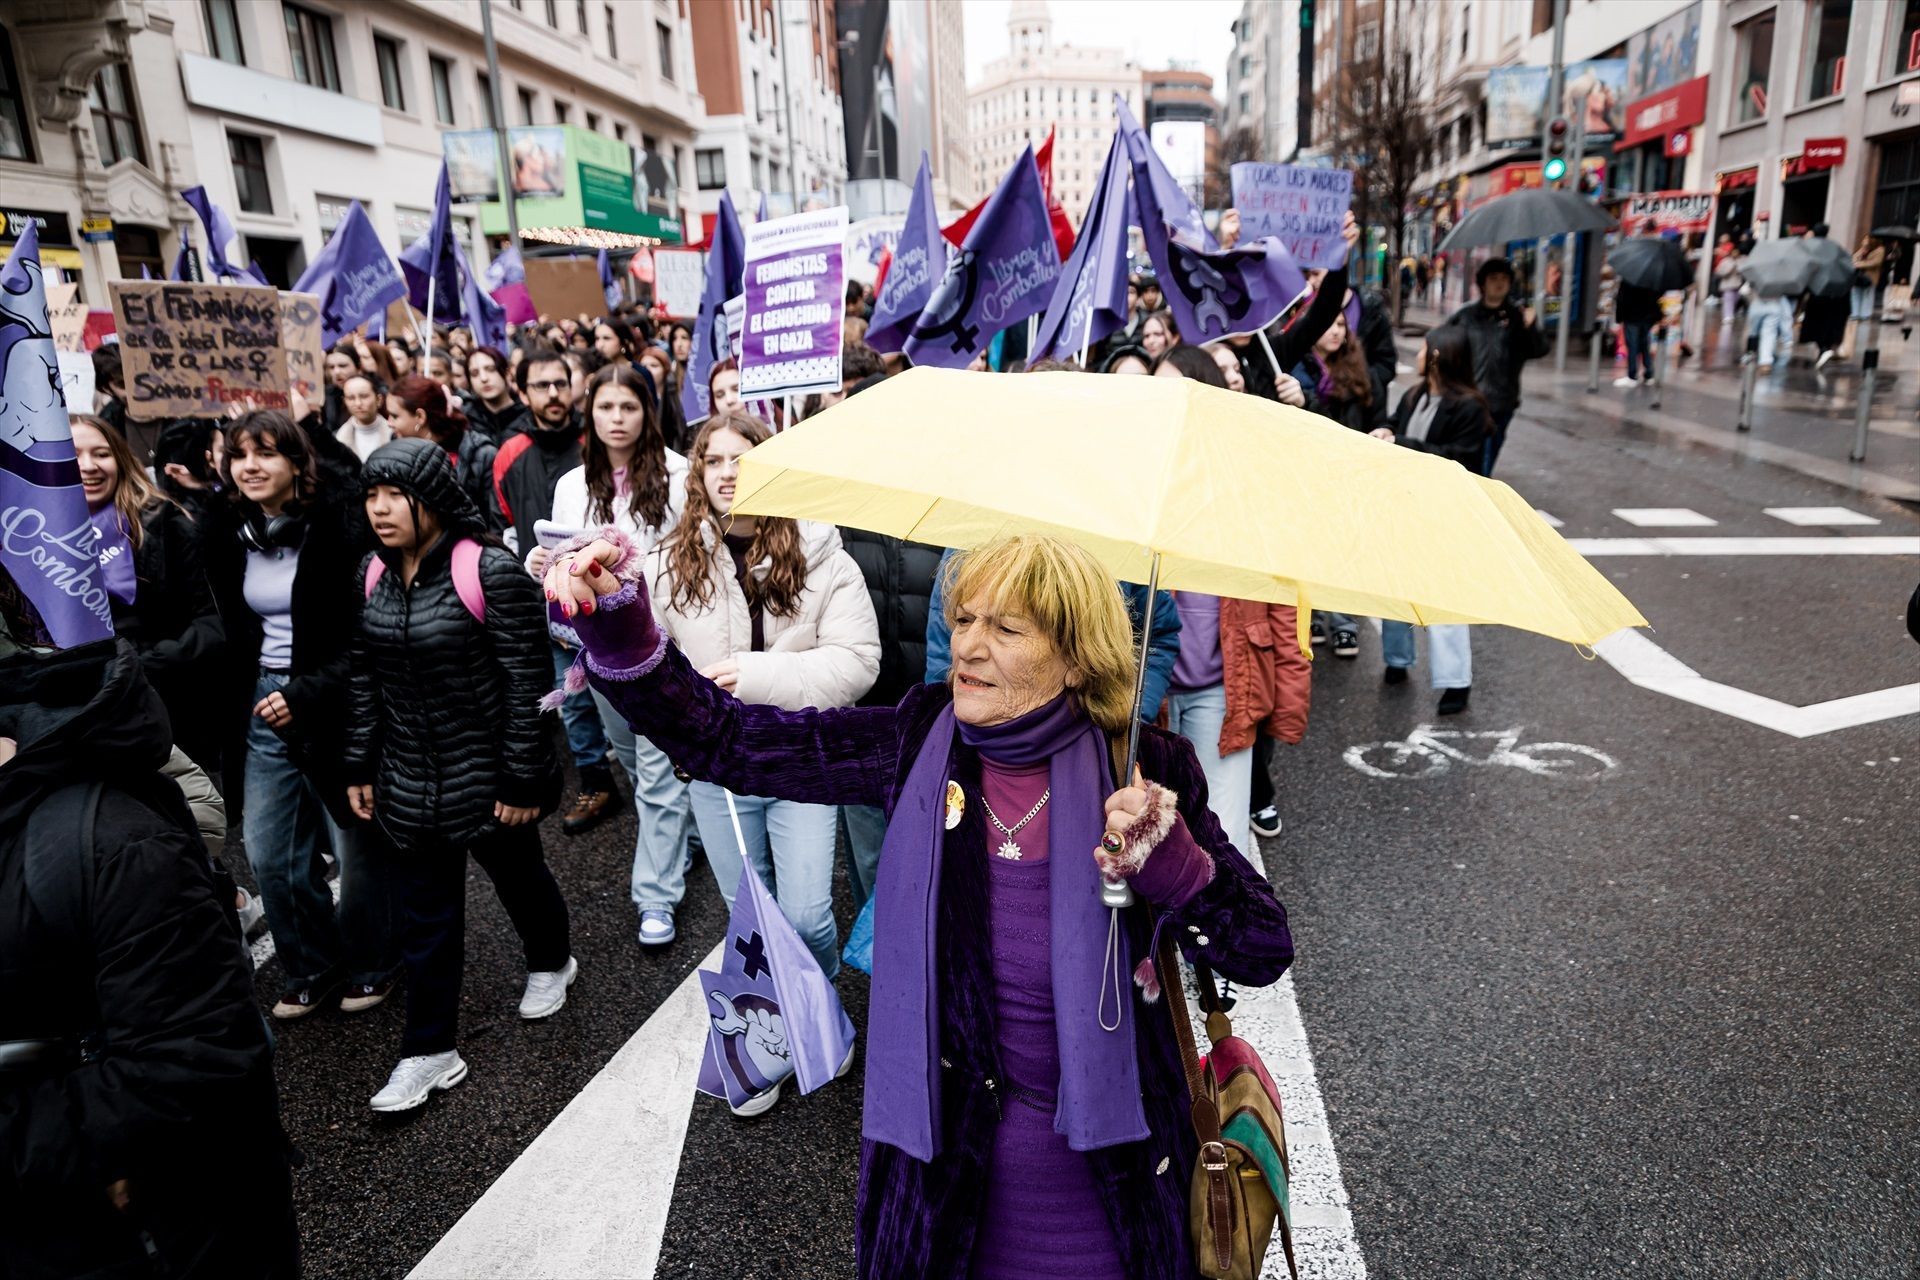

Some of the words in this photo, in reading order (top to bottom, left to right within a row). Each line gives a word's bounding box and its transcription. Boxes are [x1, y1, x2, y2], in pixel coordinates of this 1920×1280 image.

[1287, 169, 1307, 188] LAS
[1633, 194, 1712, 214] MADRID
[1281, 212, 1302, 233] SUS
[756, 253, 828, 285] FEMINISTAS
[988, 246, 1039, 297] Libres
[766, 280, 815, 307] CONTRA
[750, 313, 762, 334] EL
[763, 303, 832, 331] GENOCIDIO
[151, 327, 173, 349] la
[179, 331, 219, 350] idea
[764, 334, 779, 356] EN
[780, 330, 813, 353] GAZA
[150, 353, 175, 370] DE
[209, 355, 243, 370] LAS
